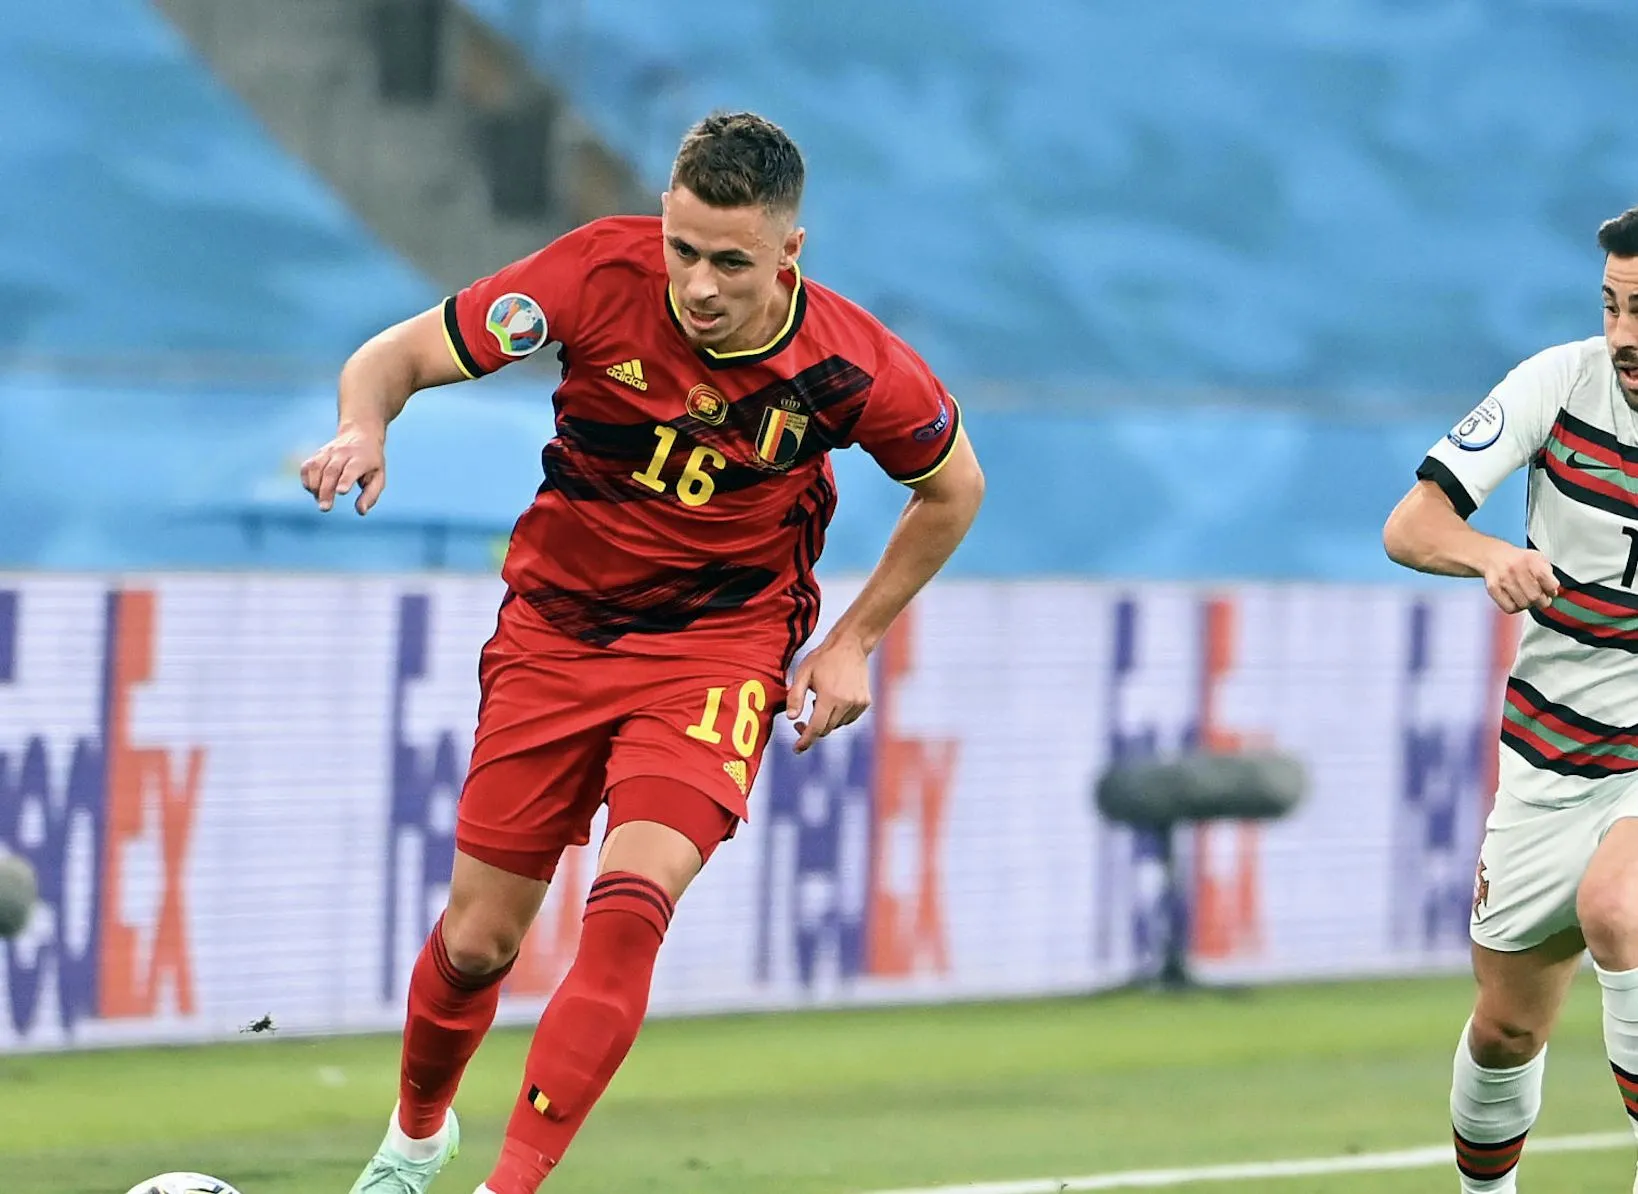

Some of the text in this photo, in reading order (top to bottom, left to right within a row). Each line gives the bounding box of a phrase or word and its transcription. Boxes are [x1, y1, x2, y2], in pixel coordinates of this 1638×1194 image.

[606, 367, 648, 391] adidas
[631, 425, 726, 507] 16
[685, 679, 766, 758] 16
